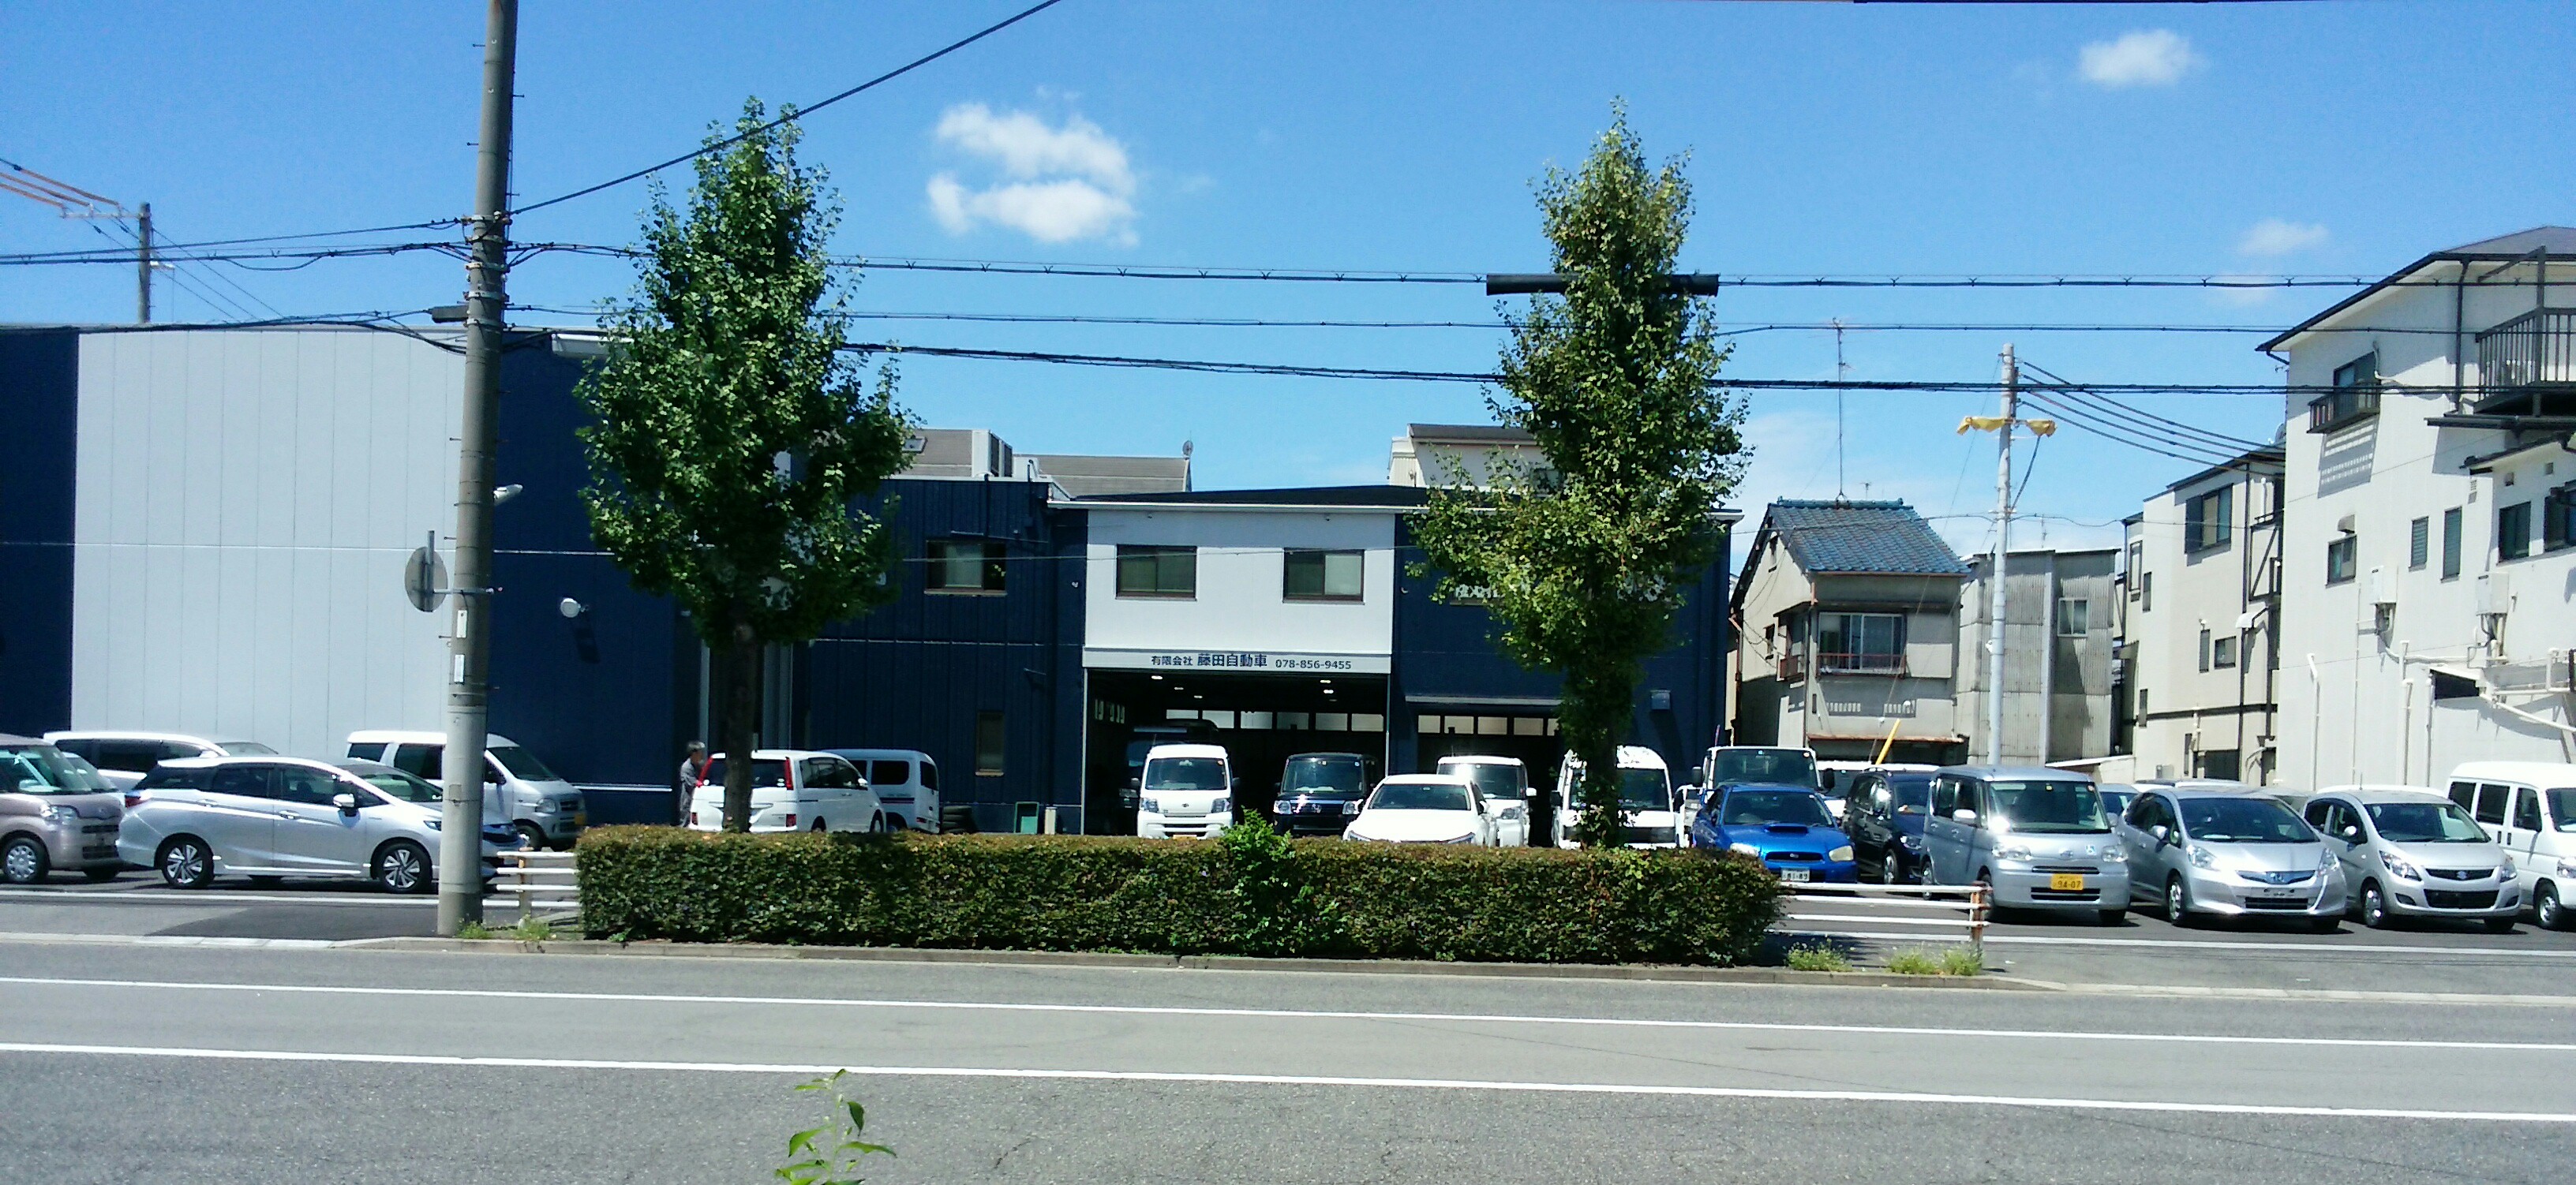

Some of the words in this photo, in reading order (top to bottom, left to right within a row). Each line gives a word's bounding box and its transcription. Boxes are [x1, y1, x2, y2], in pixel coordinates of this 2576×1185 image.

[1151, 655, 1193, 666] 有限会社
[1197, 652, 1267, 667] 藤田自動車
[1275, 659, 1352, 670] 078-856-9455
